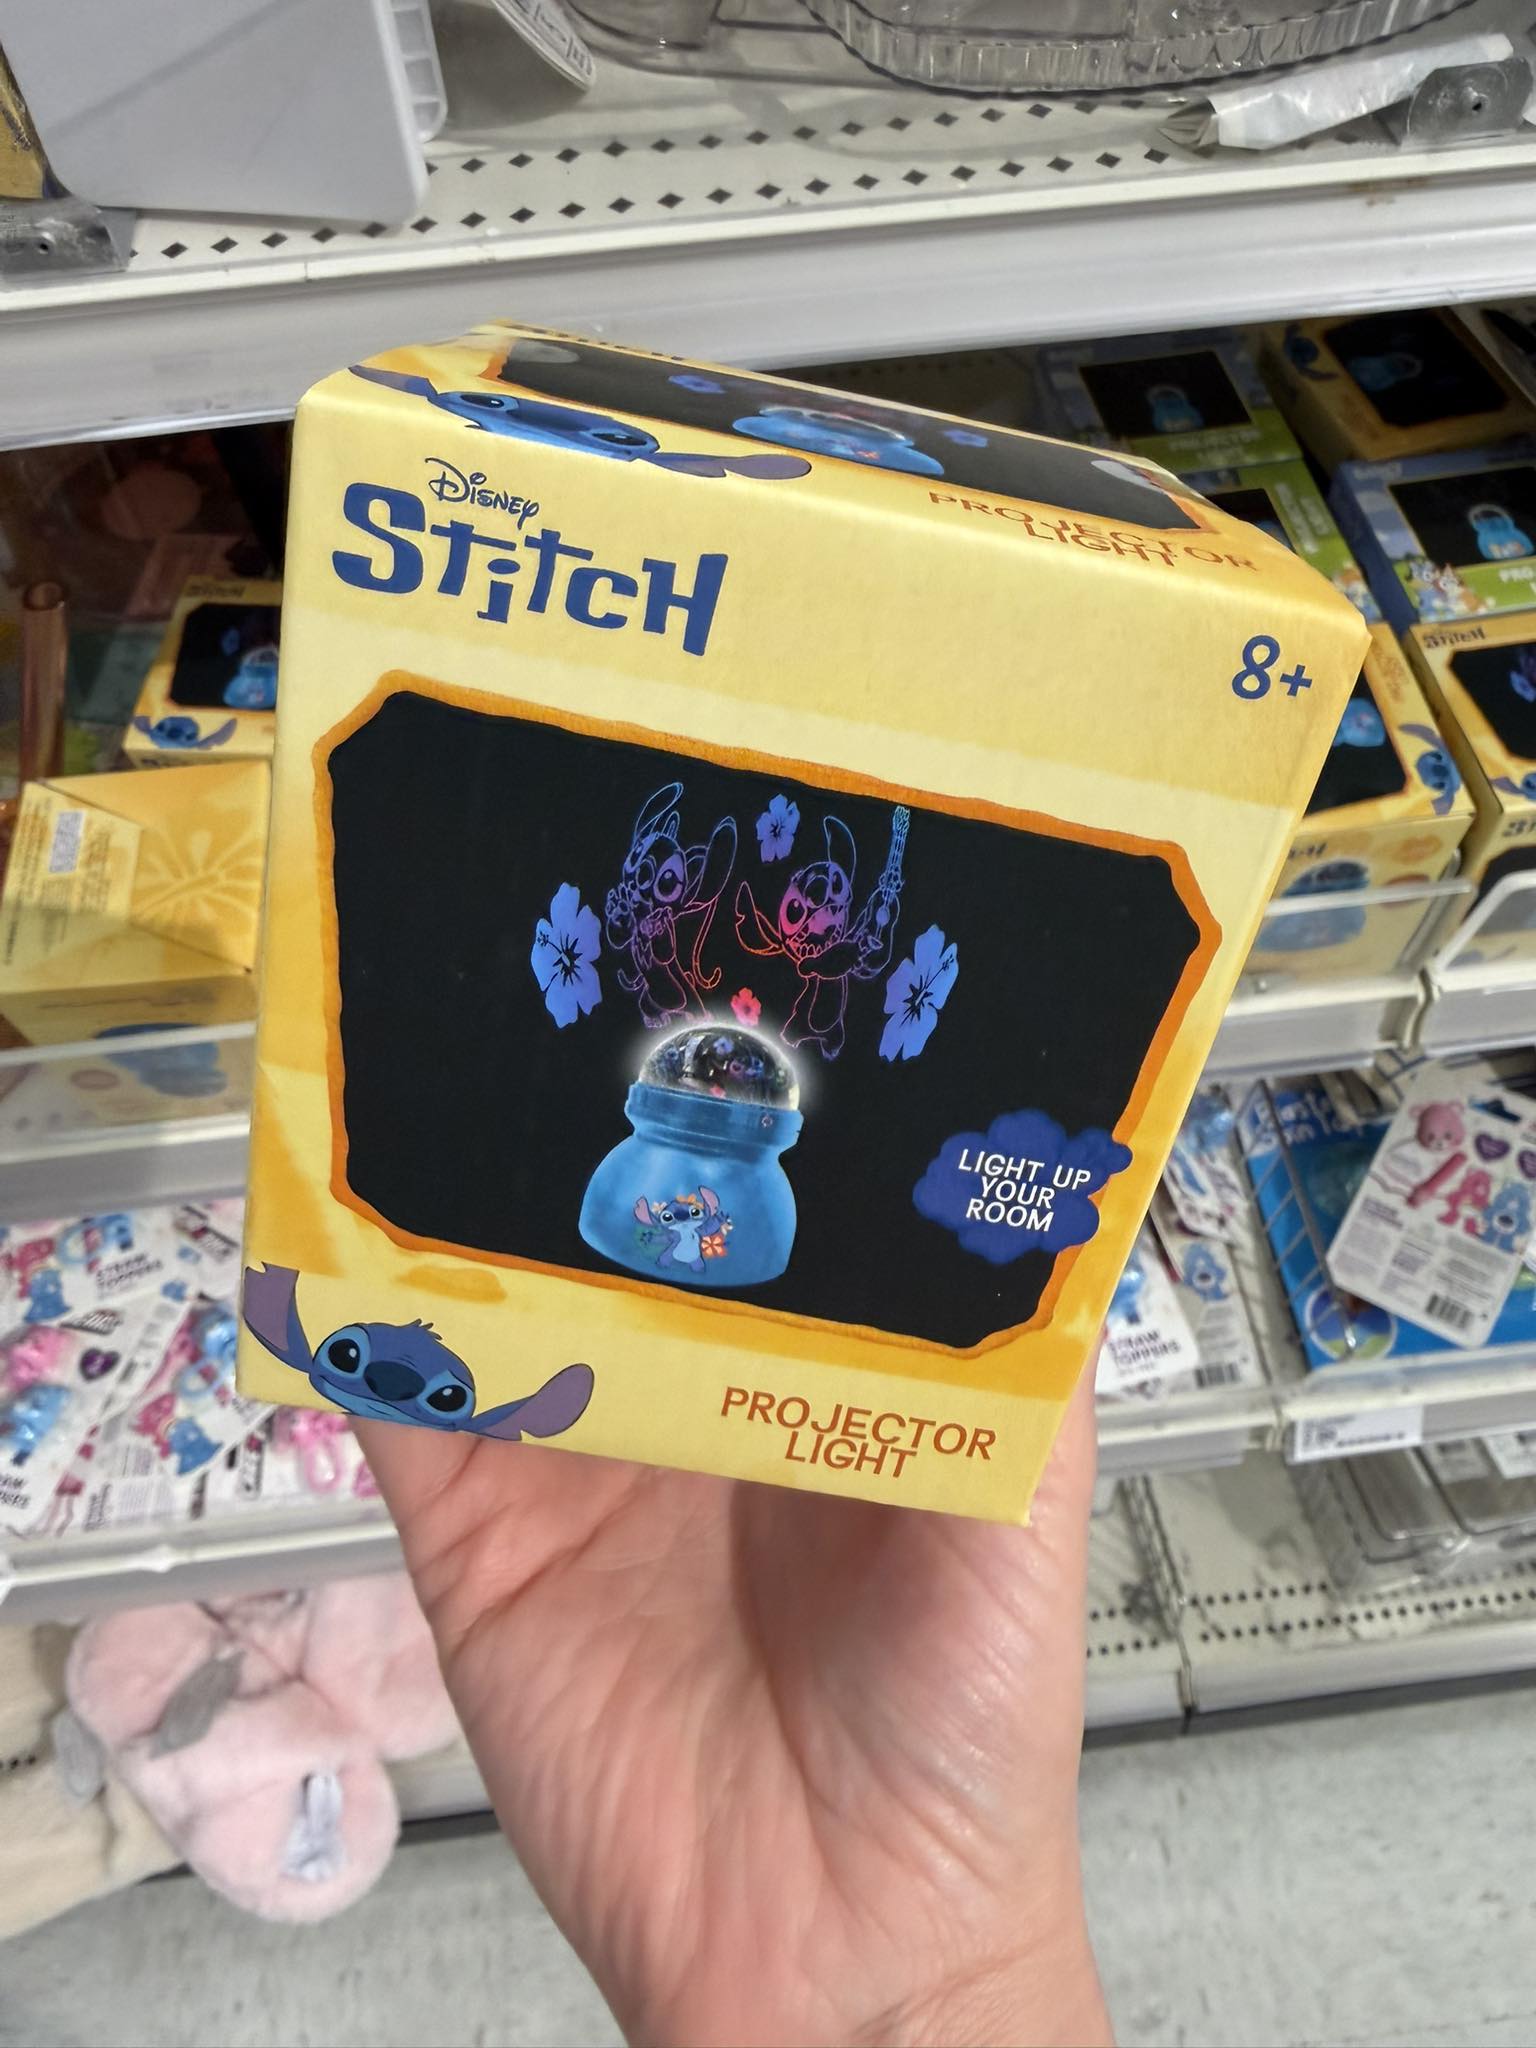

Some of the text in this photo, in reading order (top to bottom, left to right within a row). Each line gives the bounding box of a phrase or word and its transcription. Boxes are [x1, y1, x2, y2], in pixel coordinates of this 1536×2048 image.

[424, 456, 540, 530] Disney
[928, 491, 1259, 571] PROJECTOR
[1024, 521, 1176, 567] LIGHT
[1231, 634, 1313, 700] 8+
[958, 1148, 1091, 1191] LIGHT UP
[981, 1175, 1055, 1209] YOUR
[965, 1198, 1054, 1232] ROOM
[720, 1386, 997, 1461] PROJECTOR
[784, 1430, 917, 1478] LIGHT
